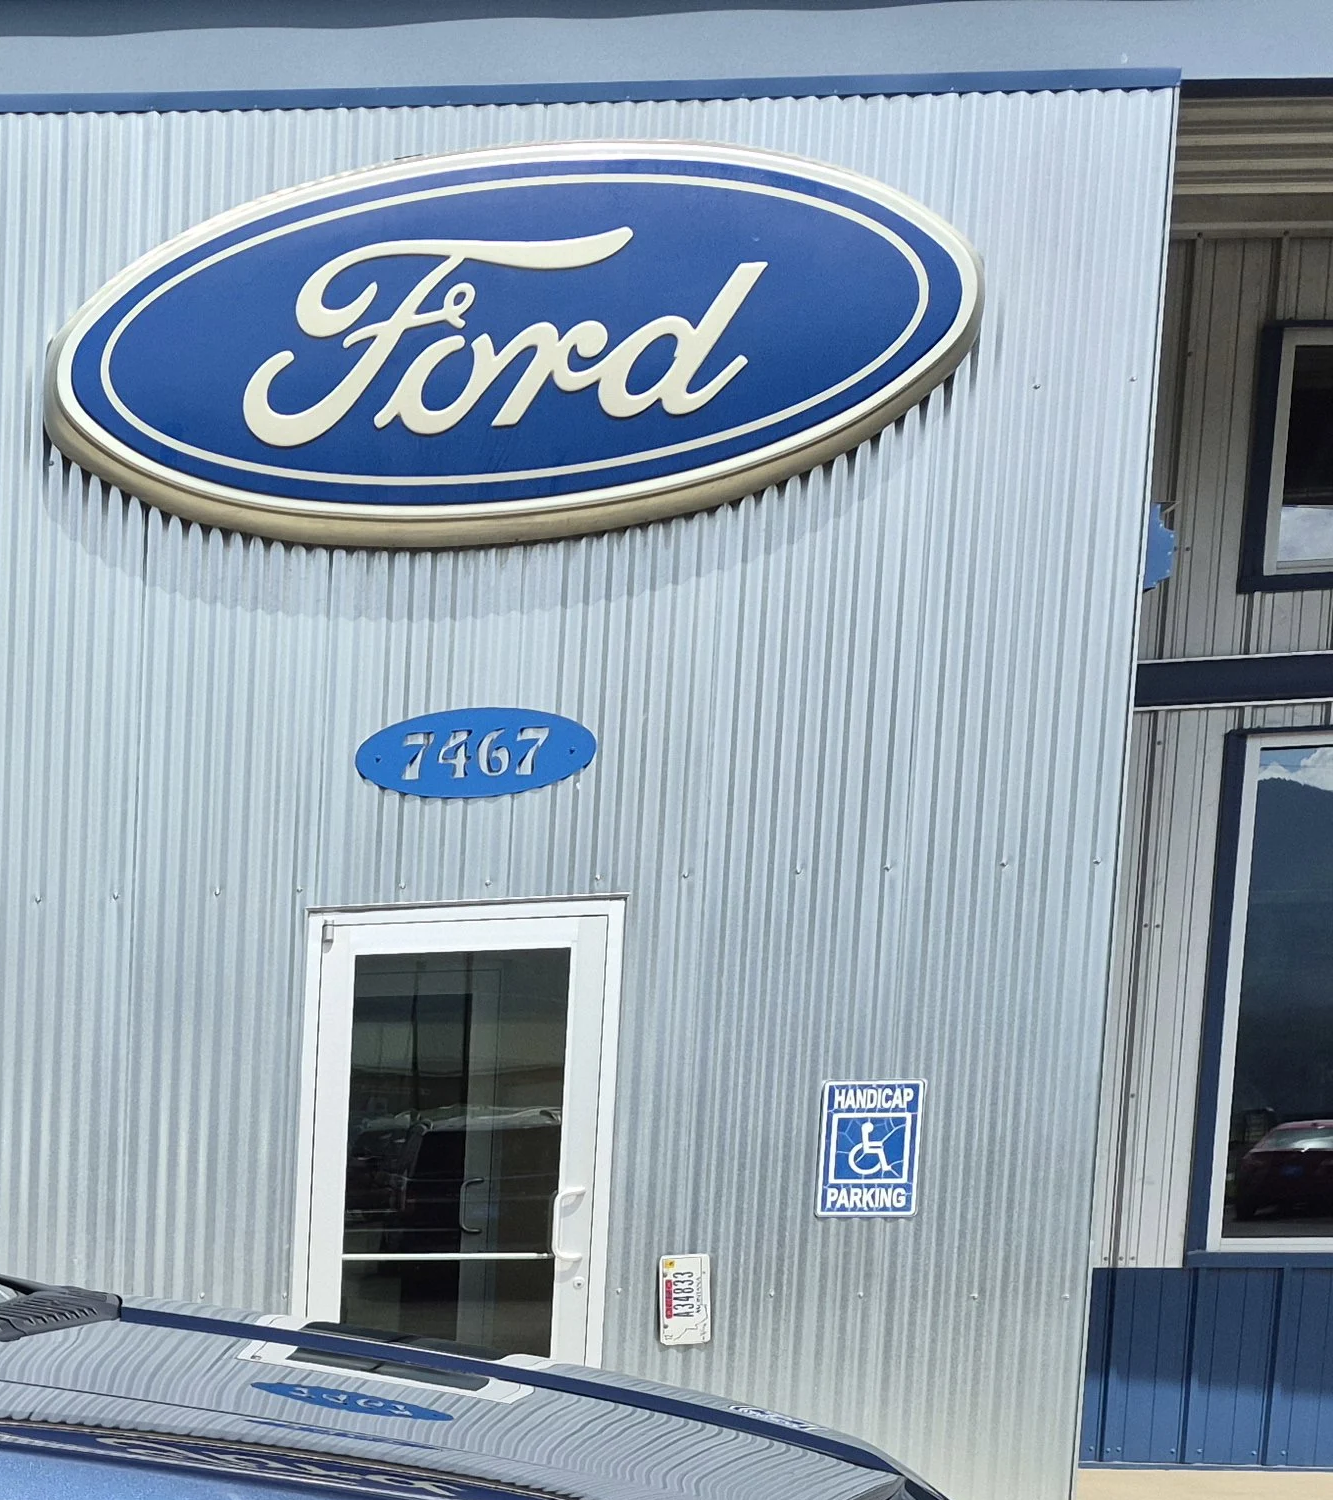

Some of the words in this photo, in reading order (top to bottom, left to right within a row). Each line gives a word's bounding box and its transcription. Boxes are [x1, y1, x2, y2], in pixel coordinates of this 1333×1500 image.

[243, 226, 768, 447] Ford
[401, 727, 550, 781] 7467
[833, 1087, 914, 1109] HANDICAP
[825, 1187, 906, 1208] PARKING
[673, 1271, 694, 1317] A34833
